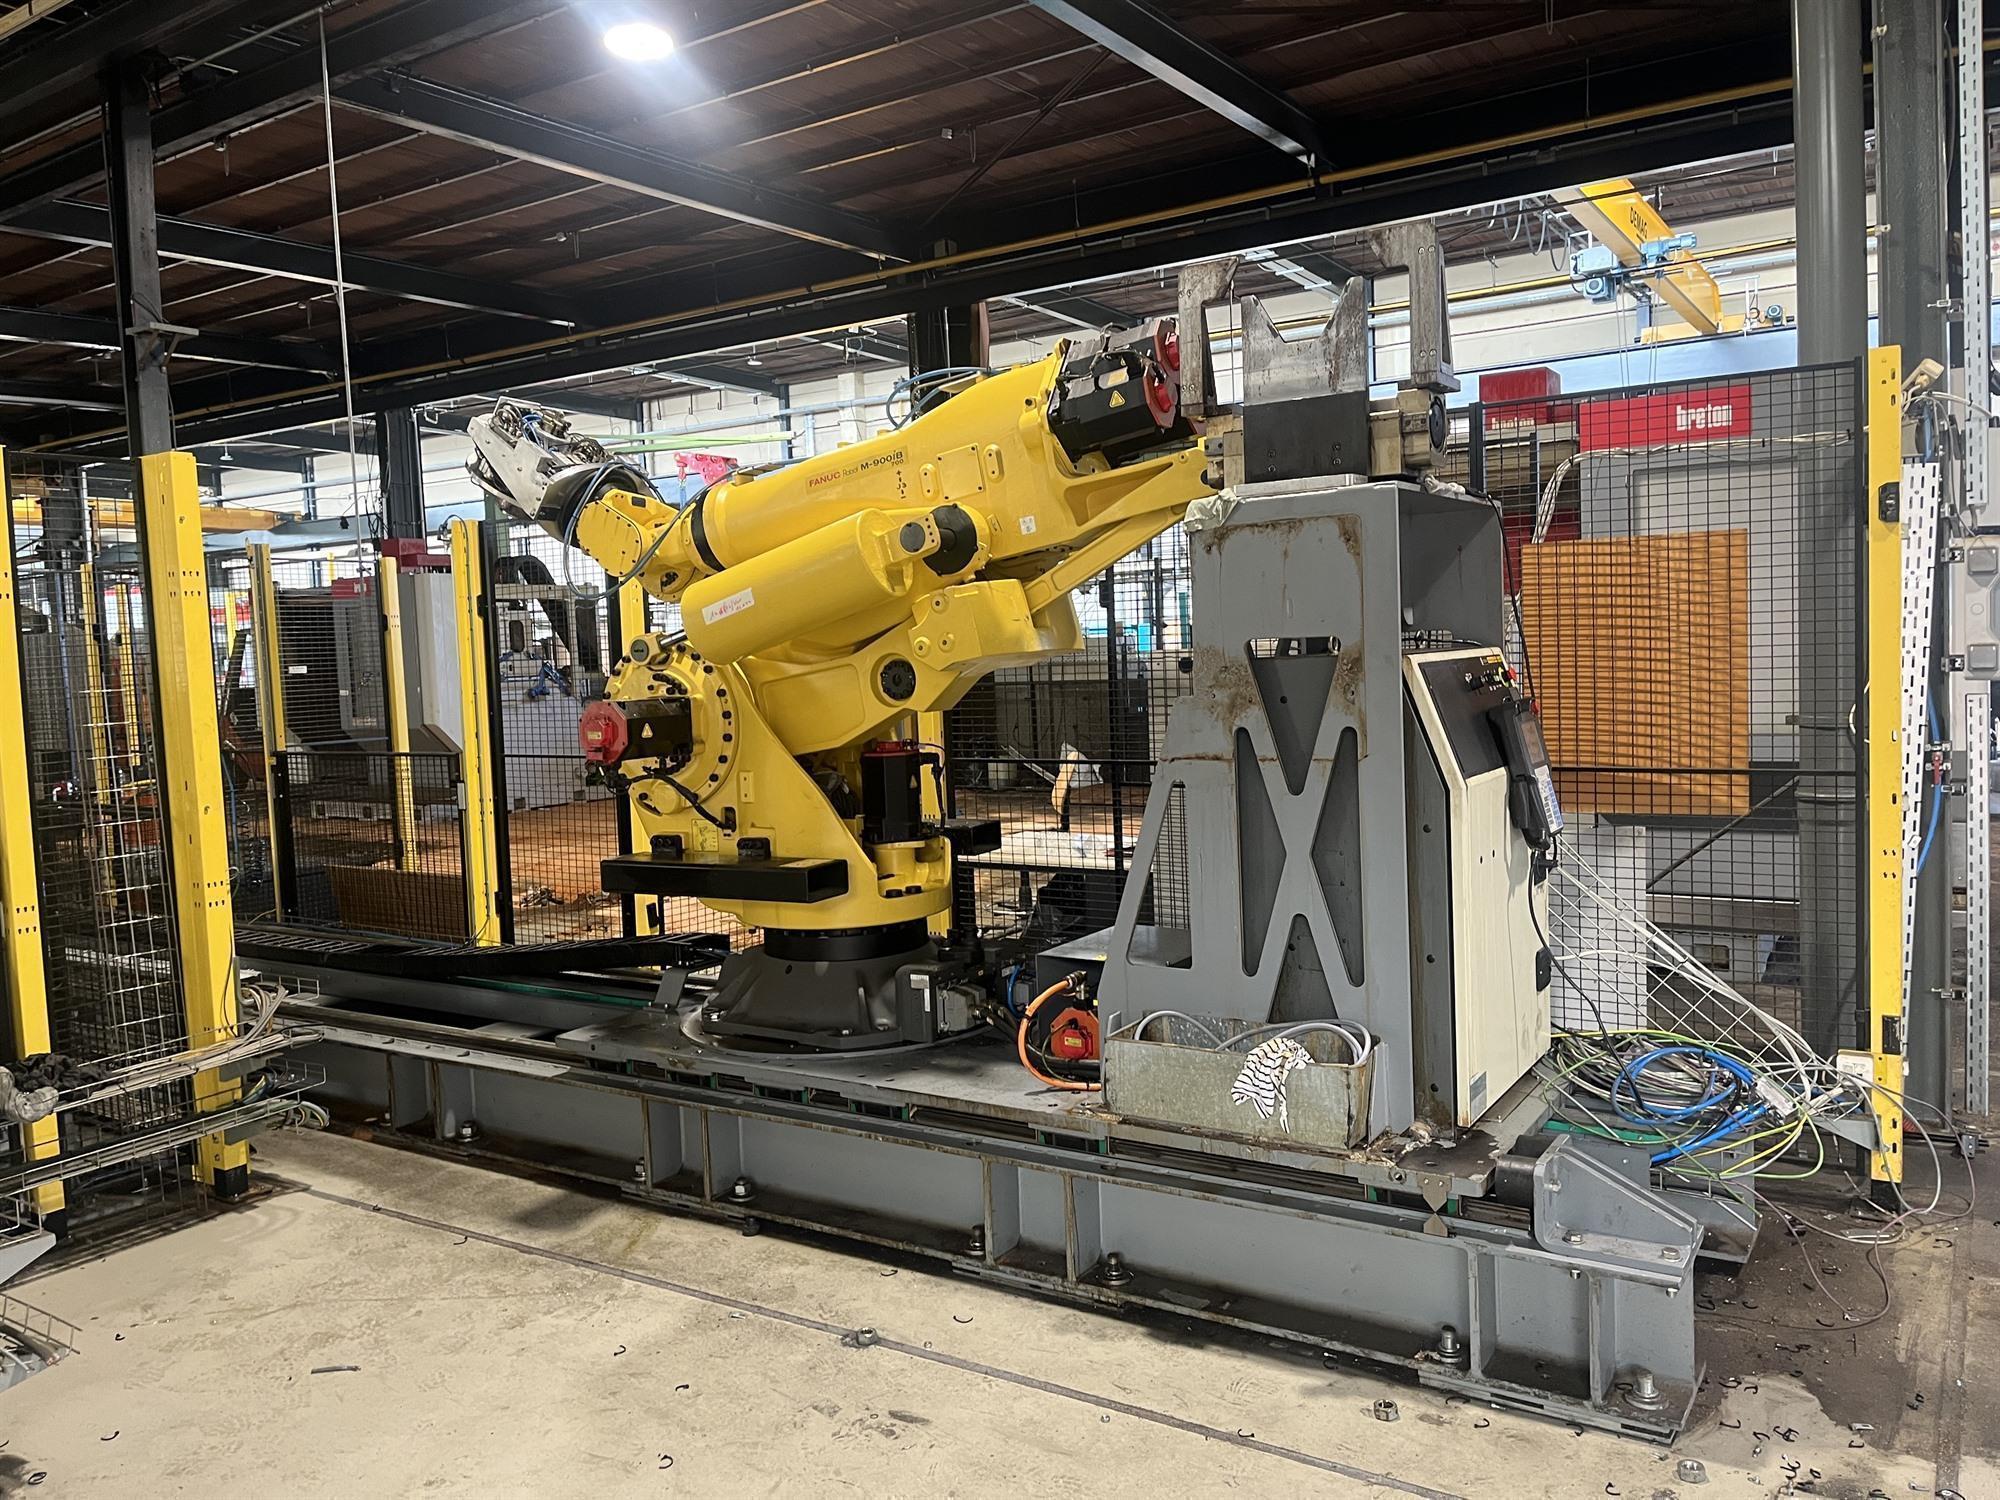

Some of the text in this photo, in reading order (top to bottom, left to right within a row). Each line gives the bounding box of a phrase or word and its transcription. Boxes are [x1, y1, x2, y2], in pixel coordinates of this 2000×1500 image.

[1630, 206, 1648, 240] DEMAG
[1676, 403, 1732, 431] breton
[891, 458, 904, 467] 700
[809, 471, 841, 487] FANUC
